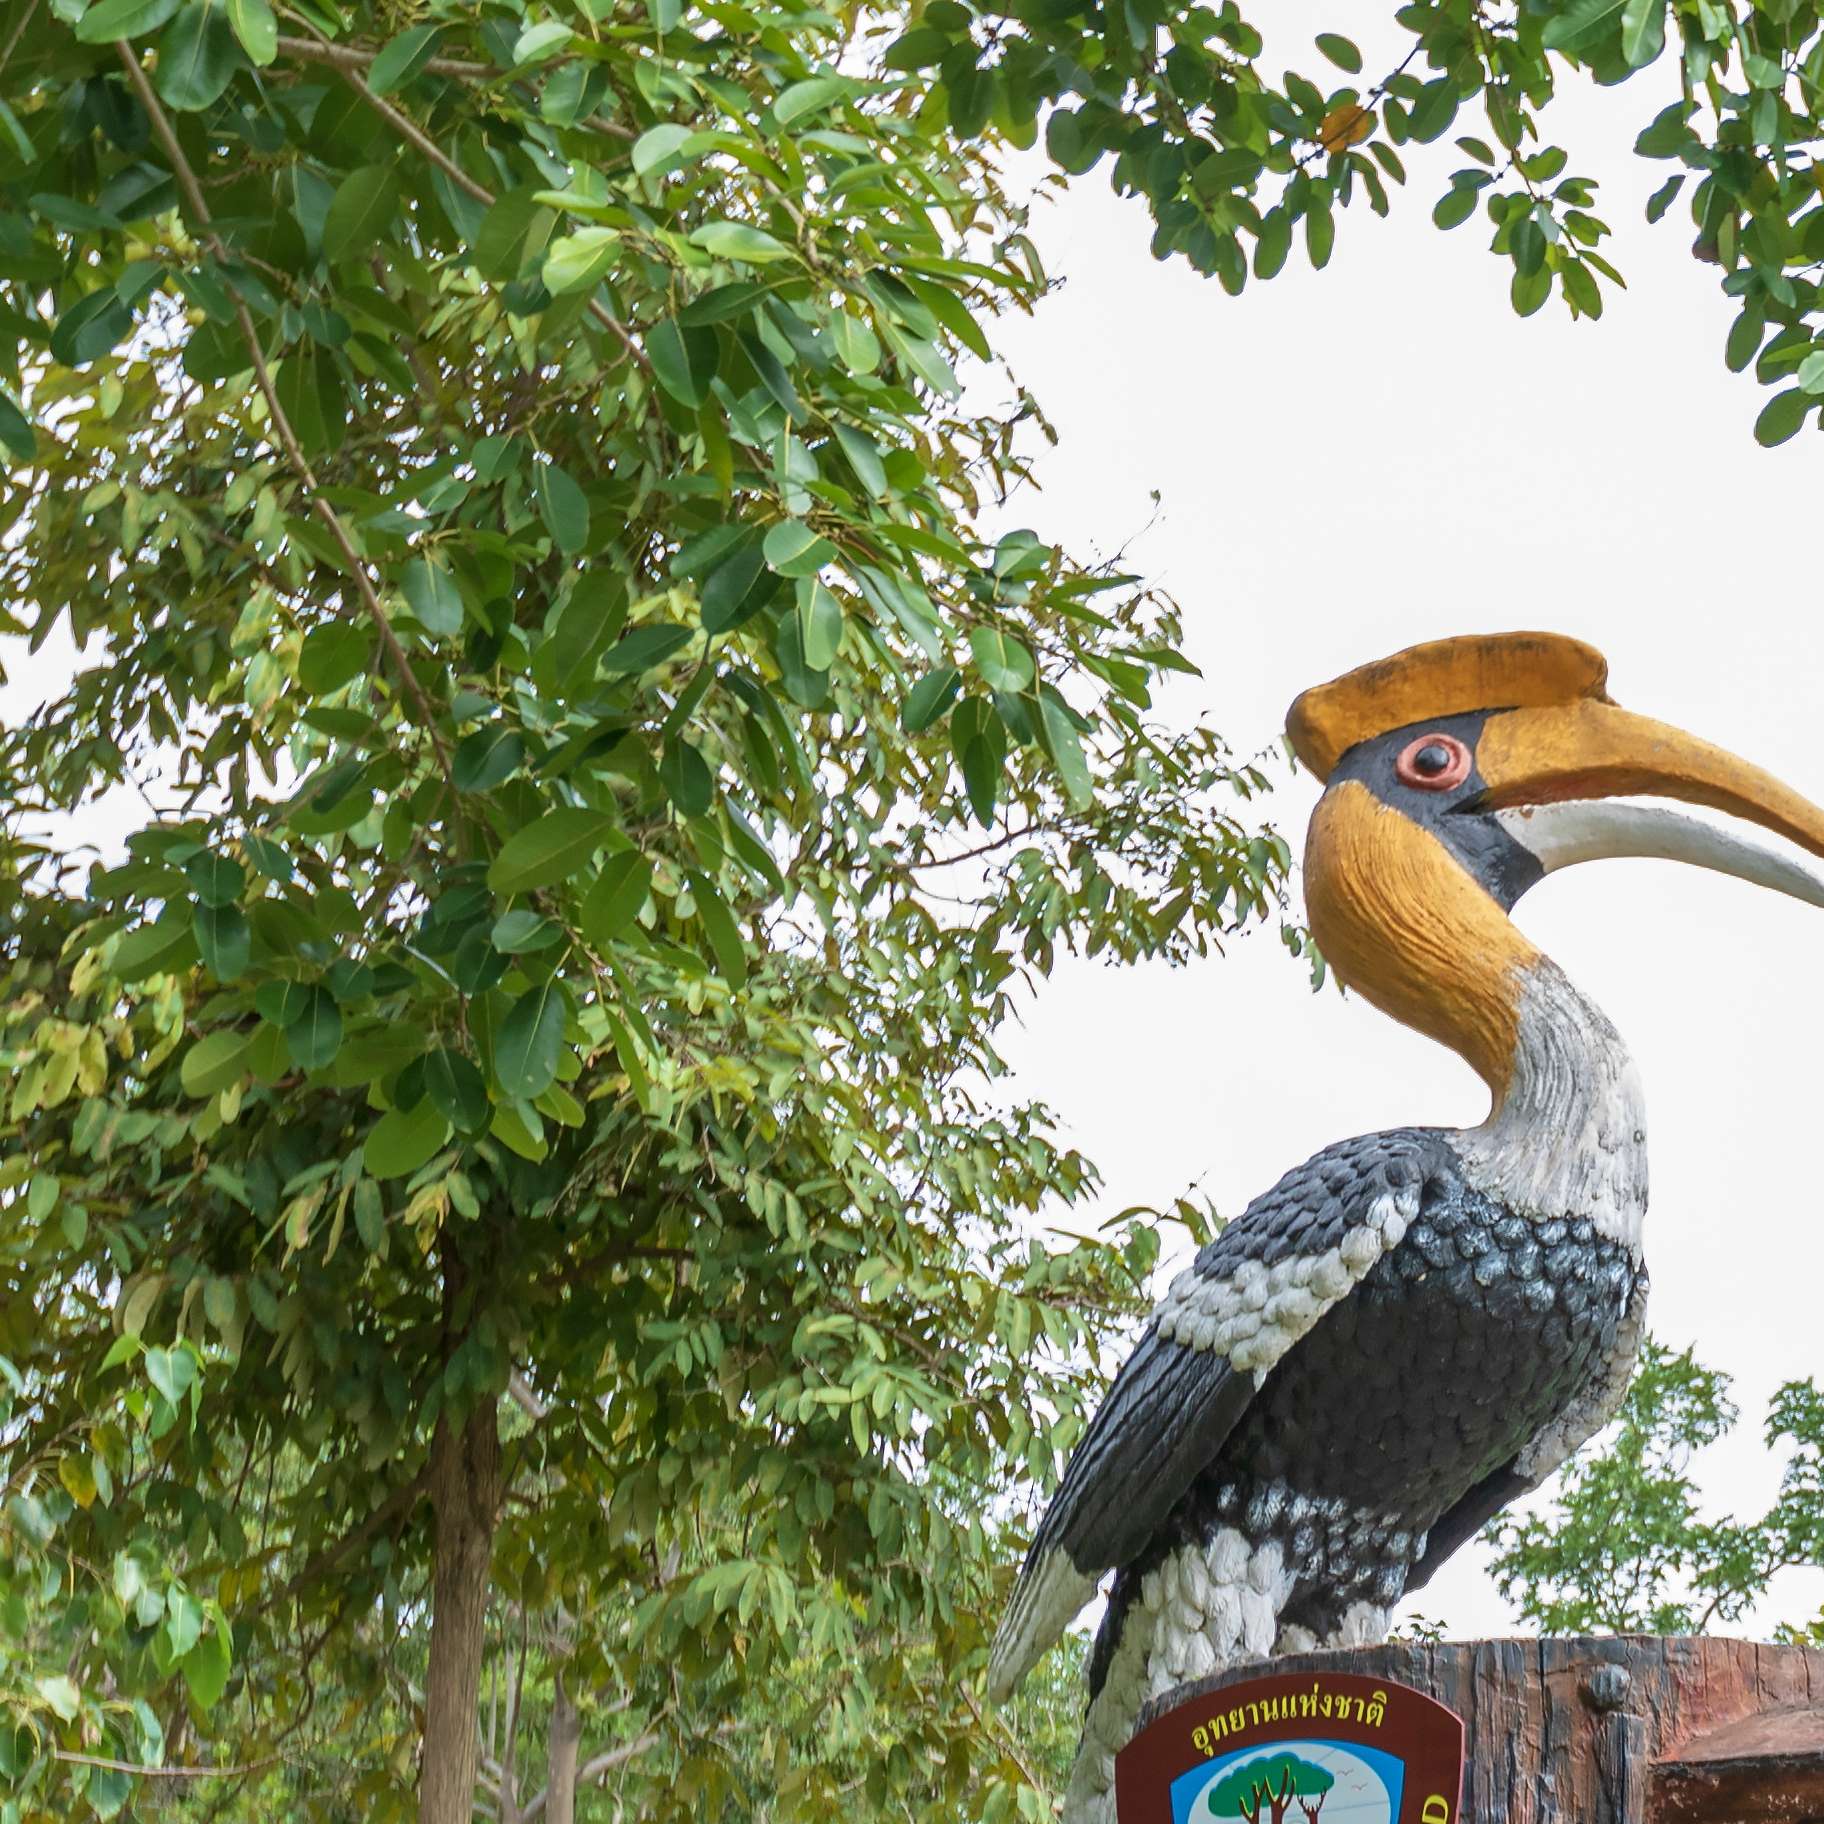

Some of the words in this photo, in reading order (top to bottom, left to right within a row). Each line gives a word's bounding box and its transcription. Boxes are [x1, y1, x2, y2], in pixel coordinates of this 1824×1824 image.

[1191, 1682, 1388, 1756] อุทยานแห่งชาติ
